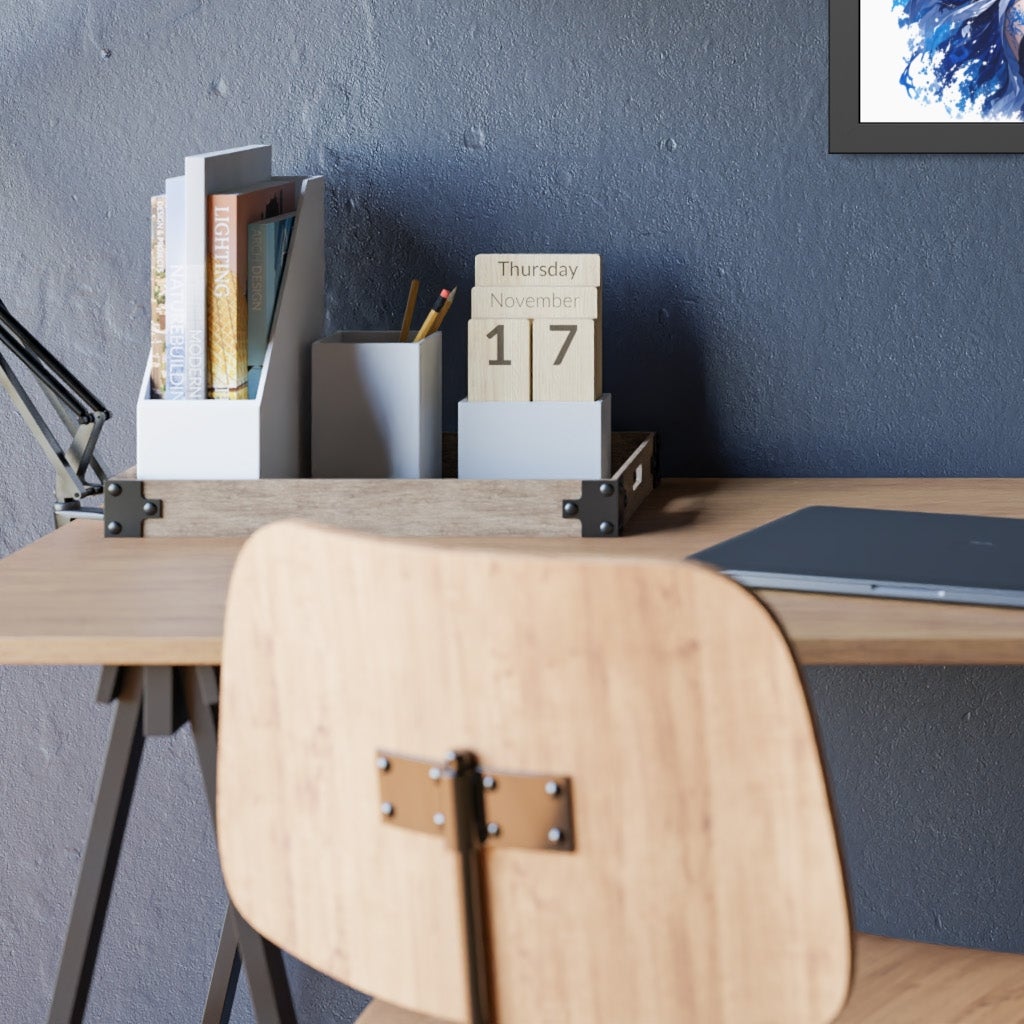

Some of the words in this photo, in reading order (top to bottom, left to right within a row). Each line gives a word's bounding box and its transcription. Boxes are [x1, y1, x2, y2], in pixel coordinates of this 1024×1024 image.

[214, 206, 230, 298] LIGHTING
[498, 261, 579, 280] Thursday
[252, 265, 263, 311] DESIGN
[490, 293, 581, 308] November
[188, 329, 203, 400] MODERN
